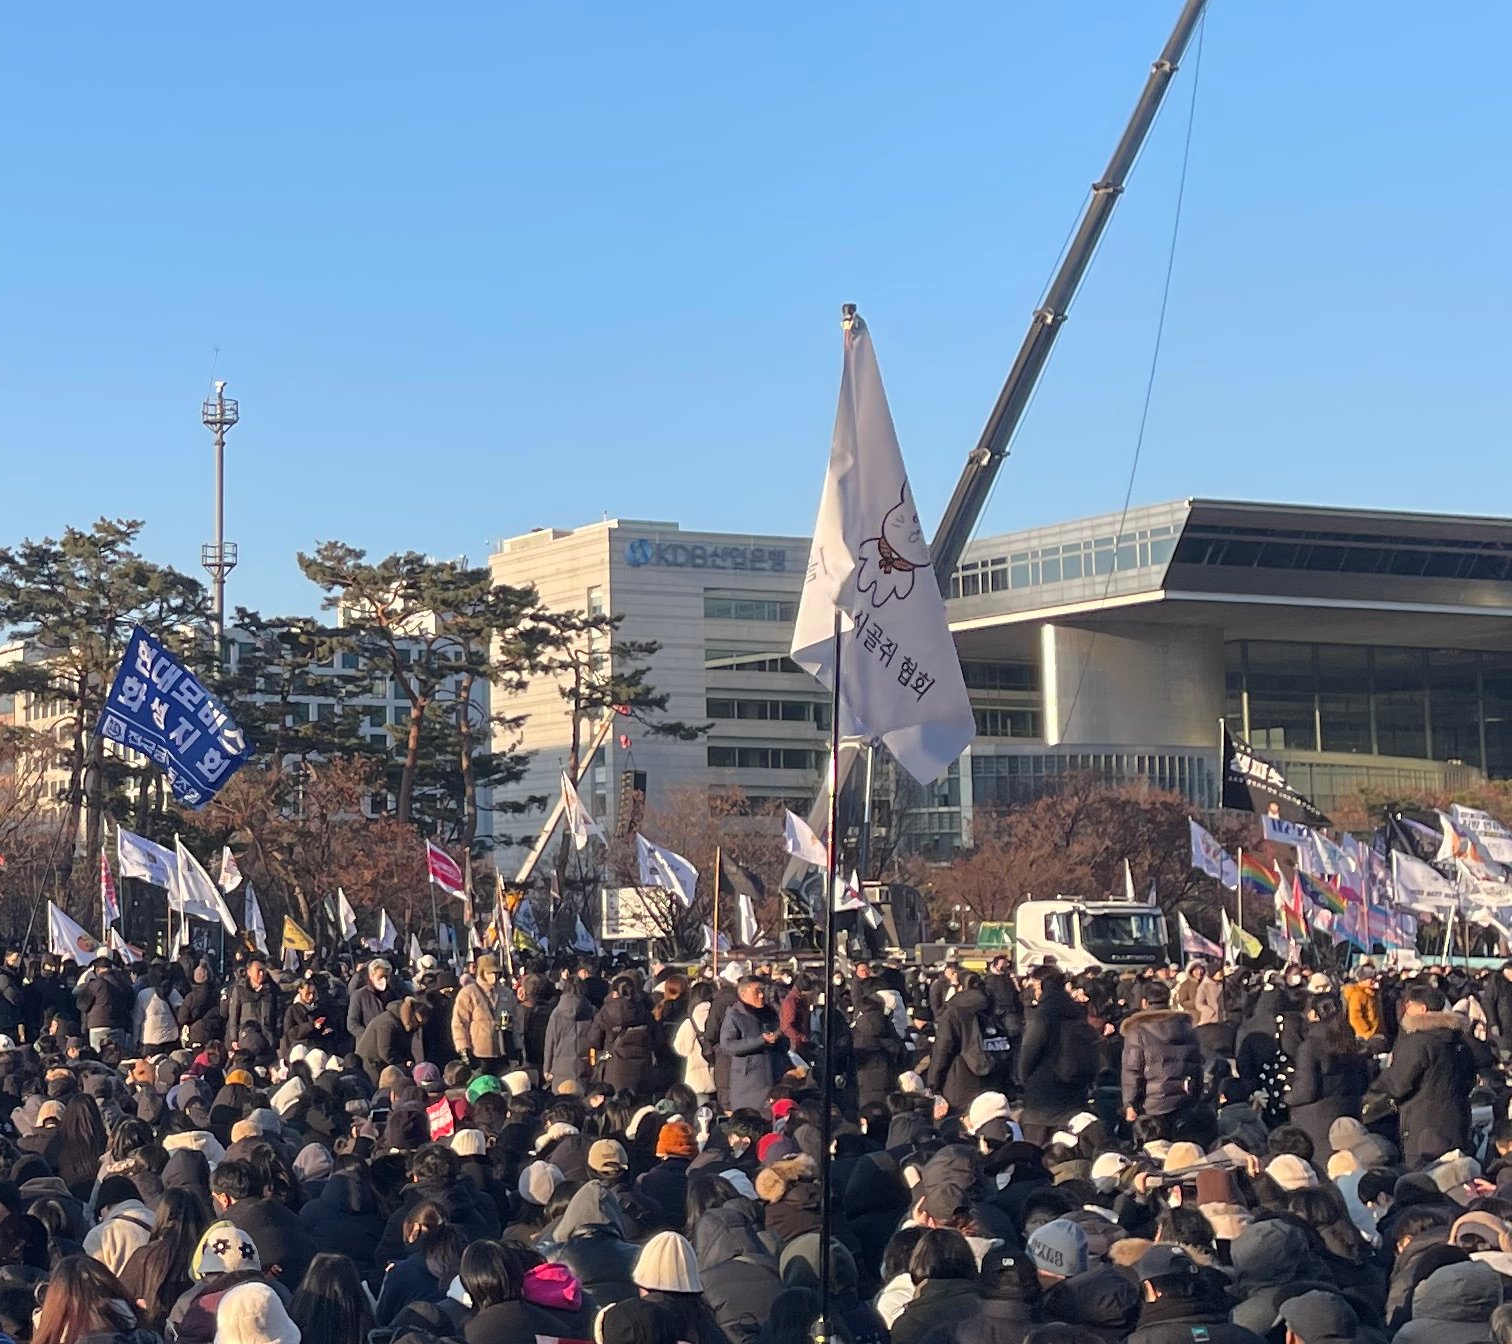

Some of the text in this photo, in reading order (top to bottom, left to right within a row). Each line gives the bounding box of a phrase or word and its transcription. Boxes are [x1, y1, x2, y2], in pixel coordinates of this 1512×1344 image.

[135, 639, 247, 755] 현대모비스
[853, 610, 936, 702] 시골쥐 협회
[117, 675, 232, 783] 화성지회
